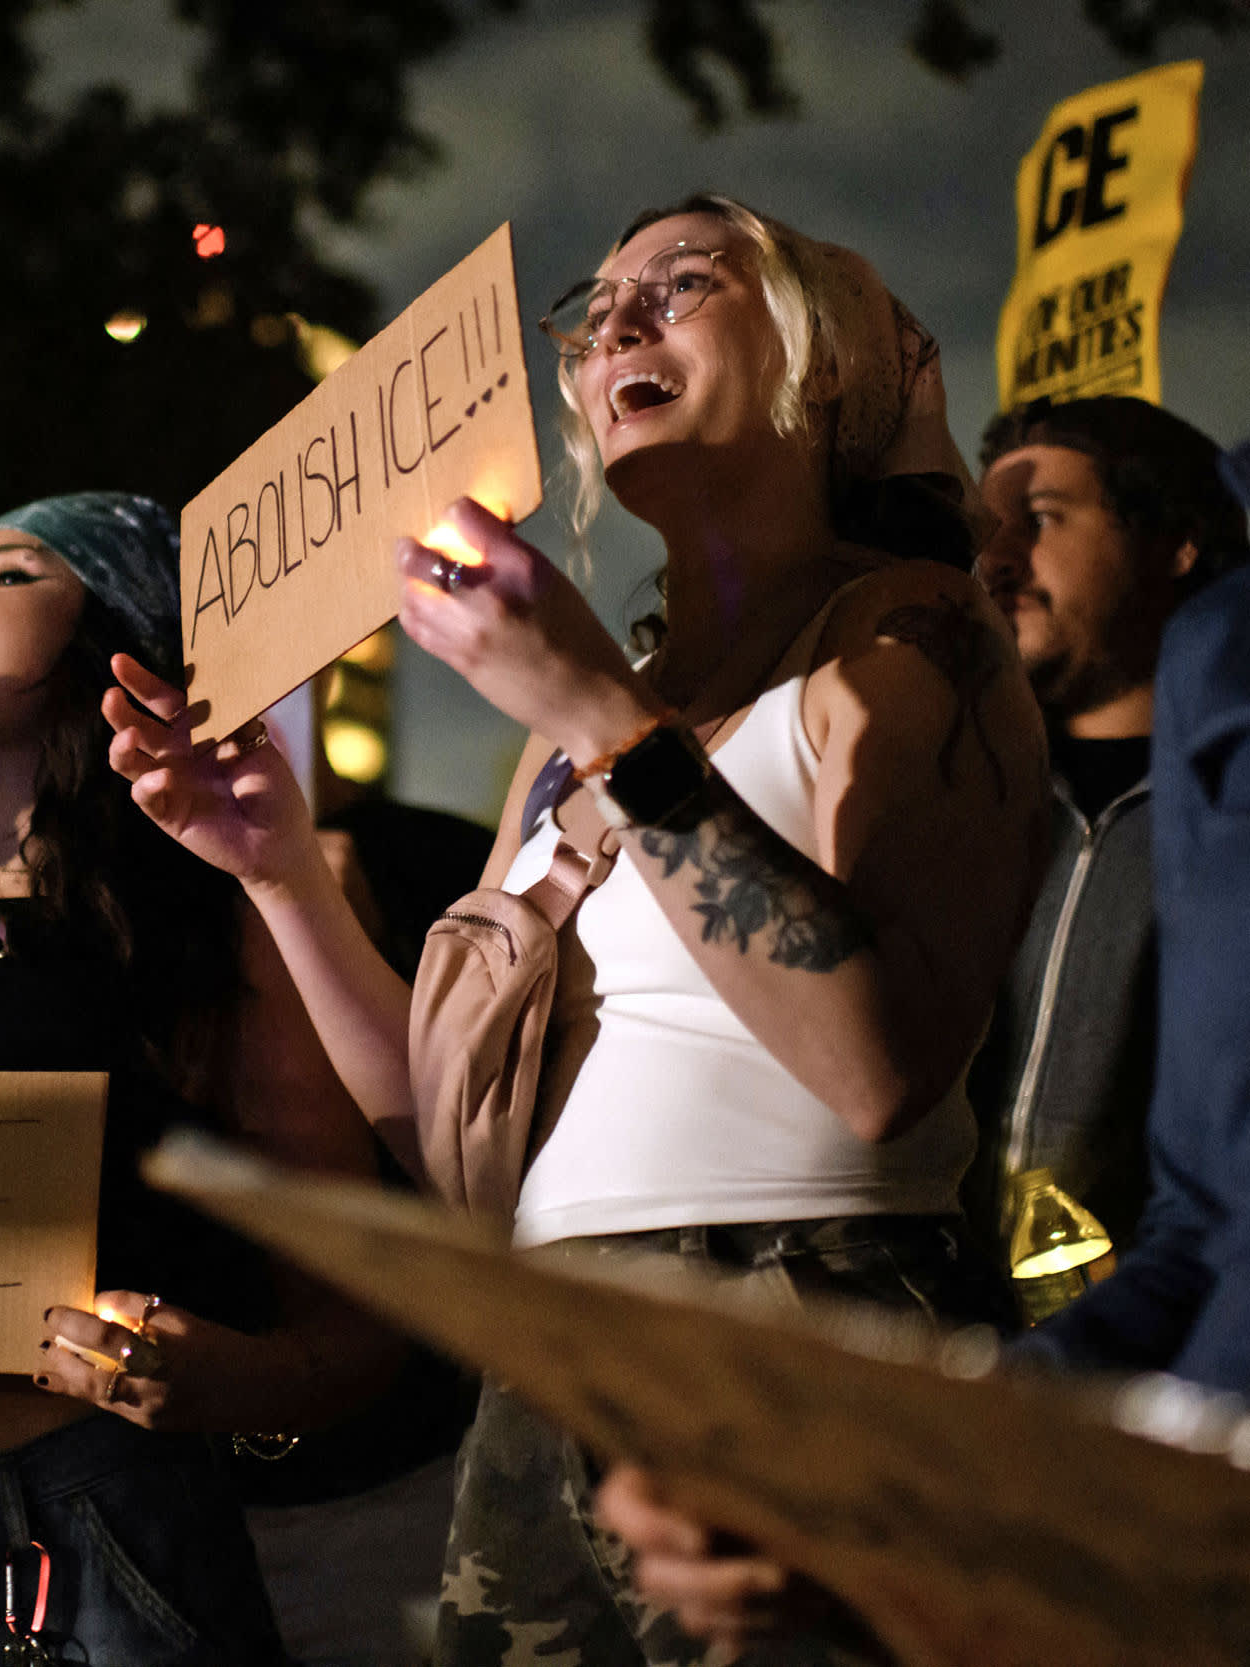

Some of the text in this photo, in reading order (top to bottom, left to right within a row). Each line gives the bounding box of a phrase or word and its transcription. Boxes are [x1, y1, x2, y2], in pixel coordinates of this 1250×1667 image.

[1033, 104, 1140, 250] CE
[190, 282, 509, 651] ABOLISH ICE!!!
